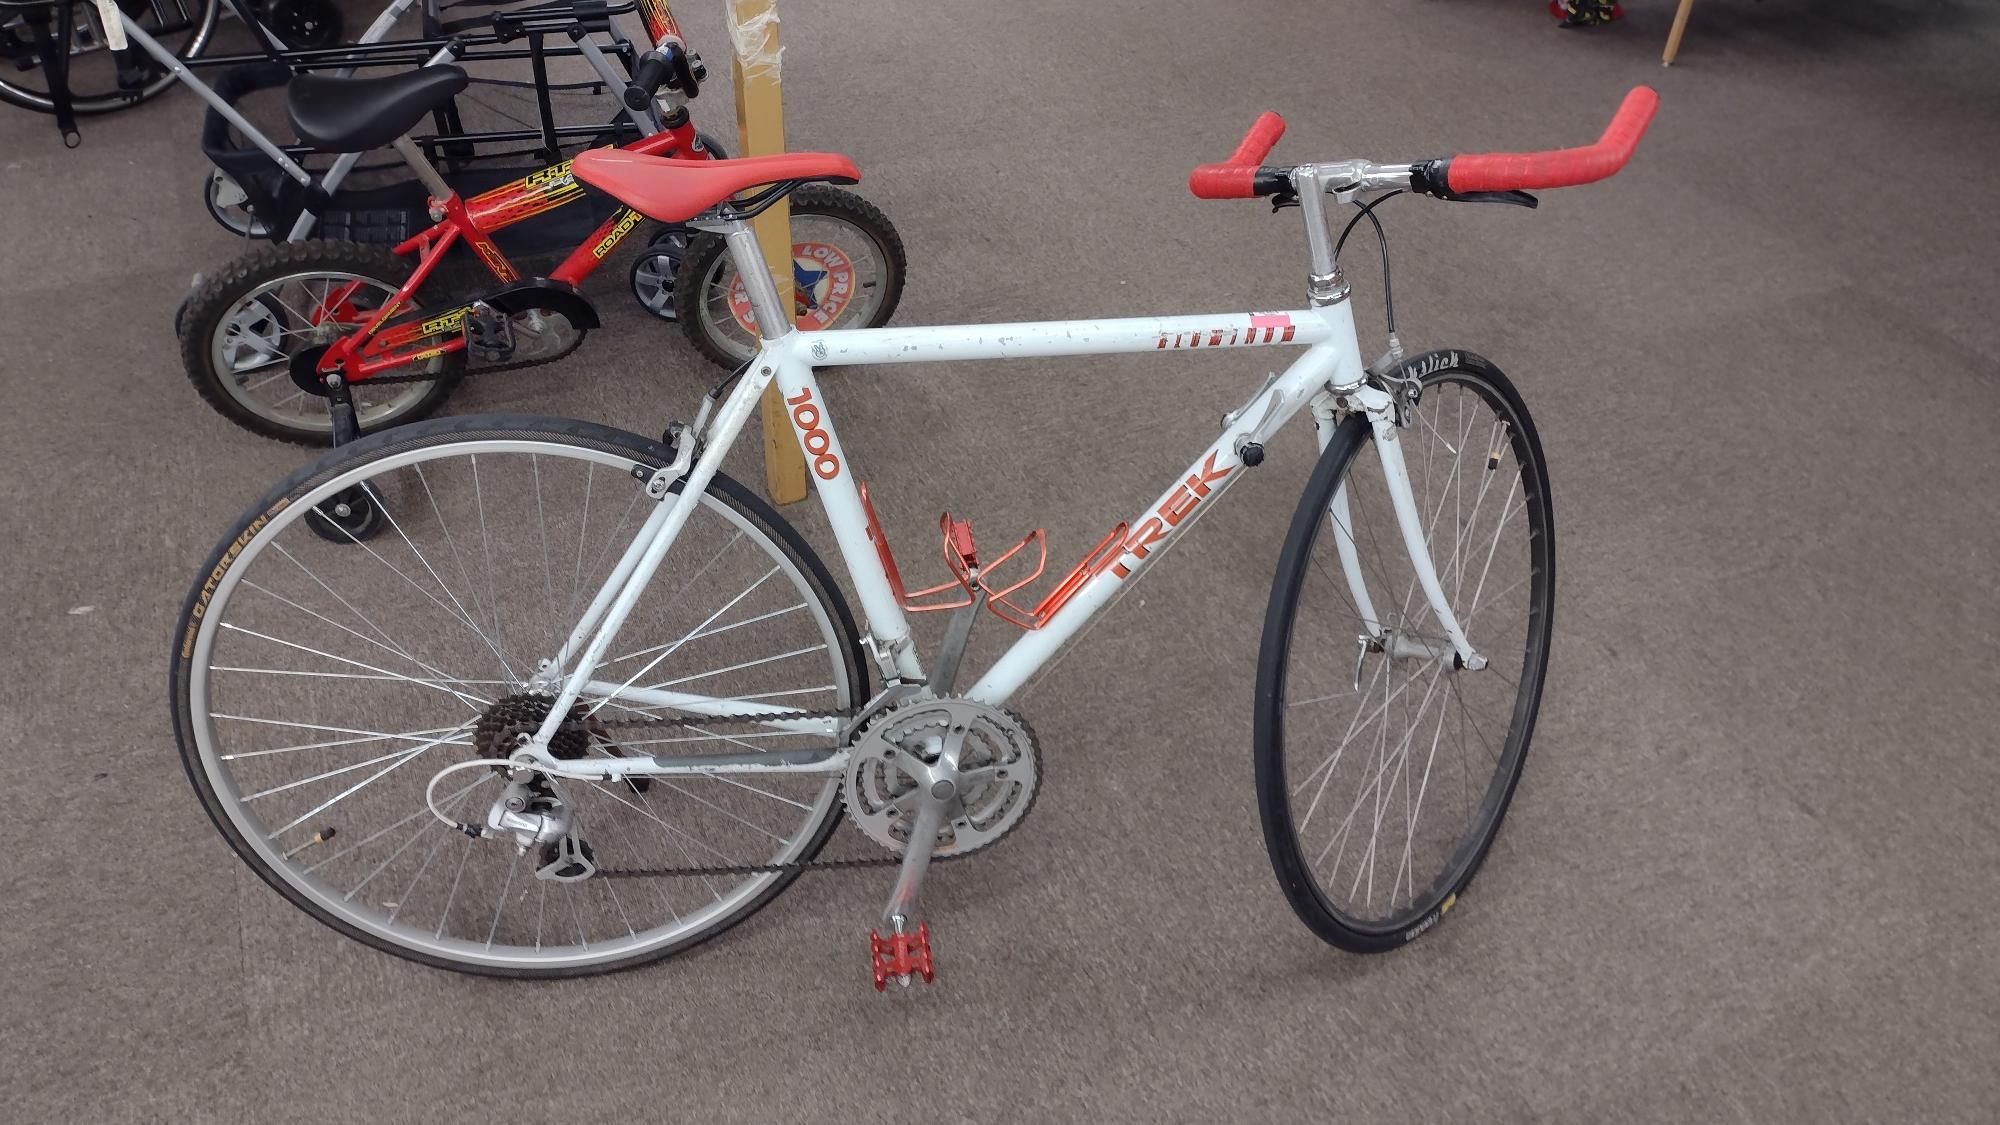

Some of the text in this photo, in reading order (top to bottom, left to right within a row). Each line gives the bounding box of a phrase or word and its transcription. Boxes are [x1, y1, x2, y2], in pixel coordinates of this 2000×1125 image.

[802, 245, 849, 323] LOW PRICE
[787, 387, 840, 480] 1000
[1095, 449, 1238, 579] TREK
